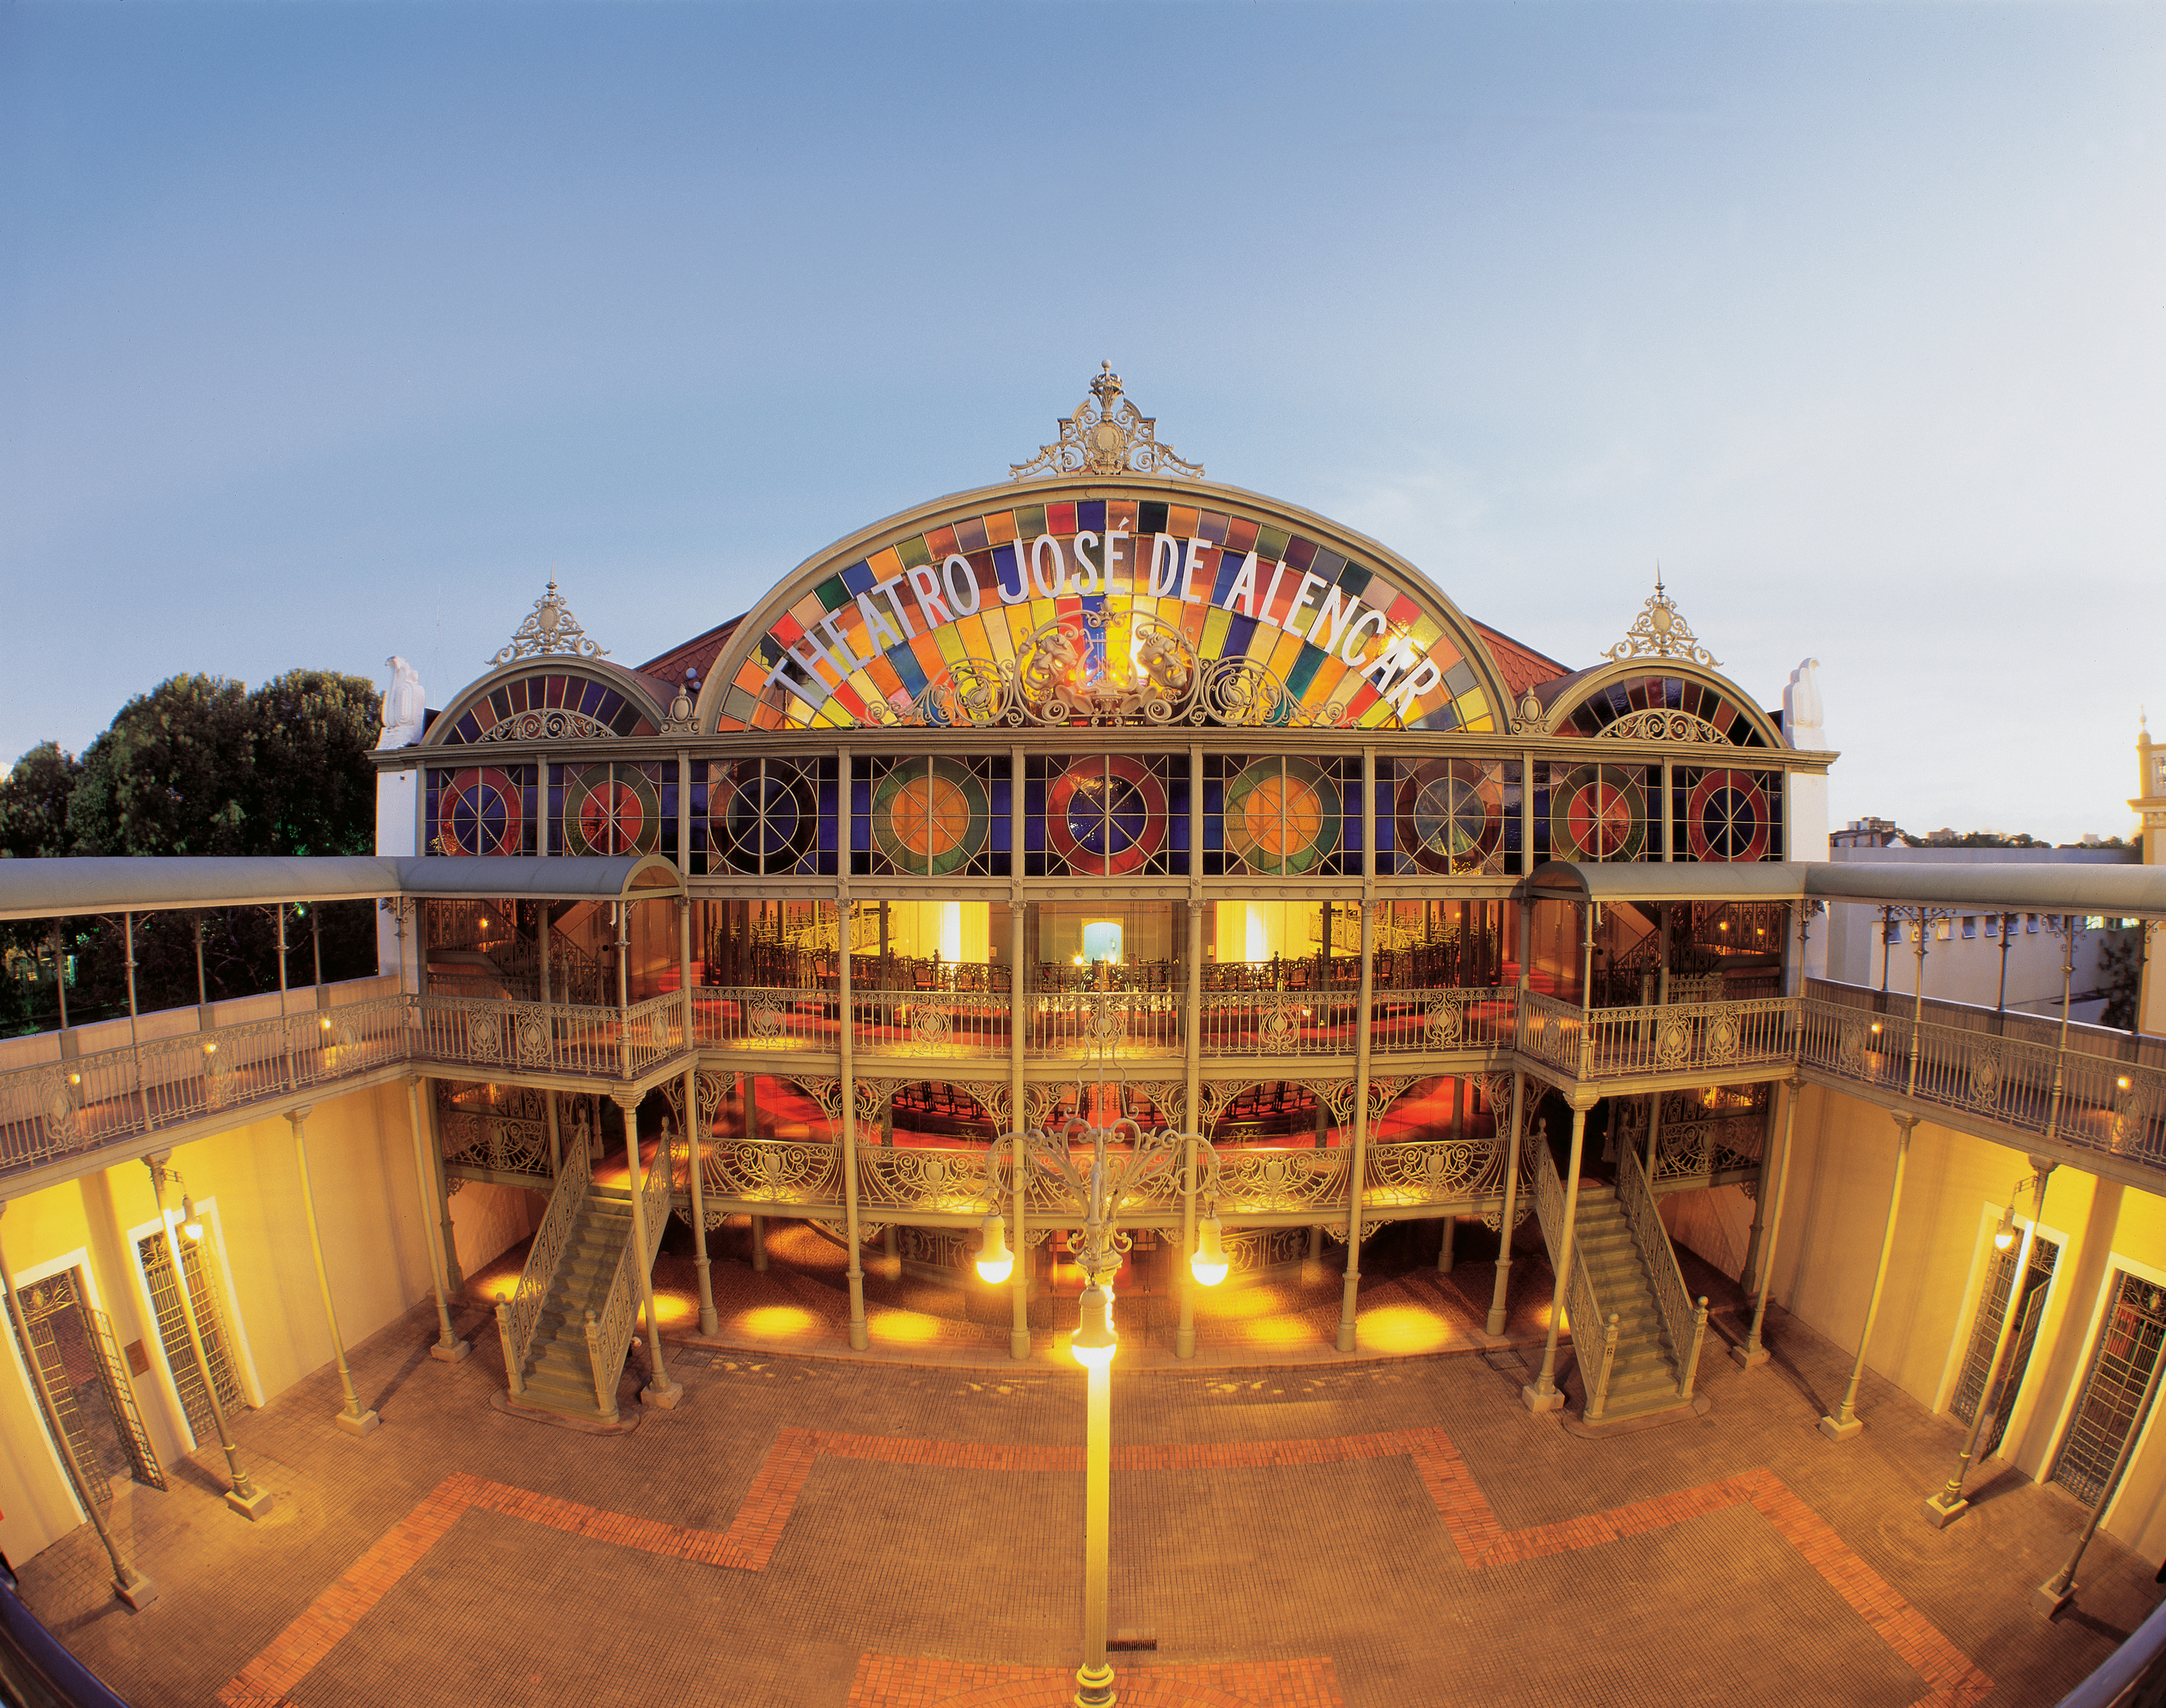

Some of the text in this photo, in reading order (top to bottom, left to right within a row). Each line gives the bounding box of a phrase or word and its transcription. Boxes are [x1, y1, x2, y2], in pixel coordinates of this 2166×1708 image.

[764, 517, 1441, 719] THEATRO JOSÉ DE ALENCAR
